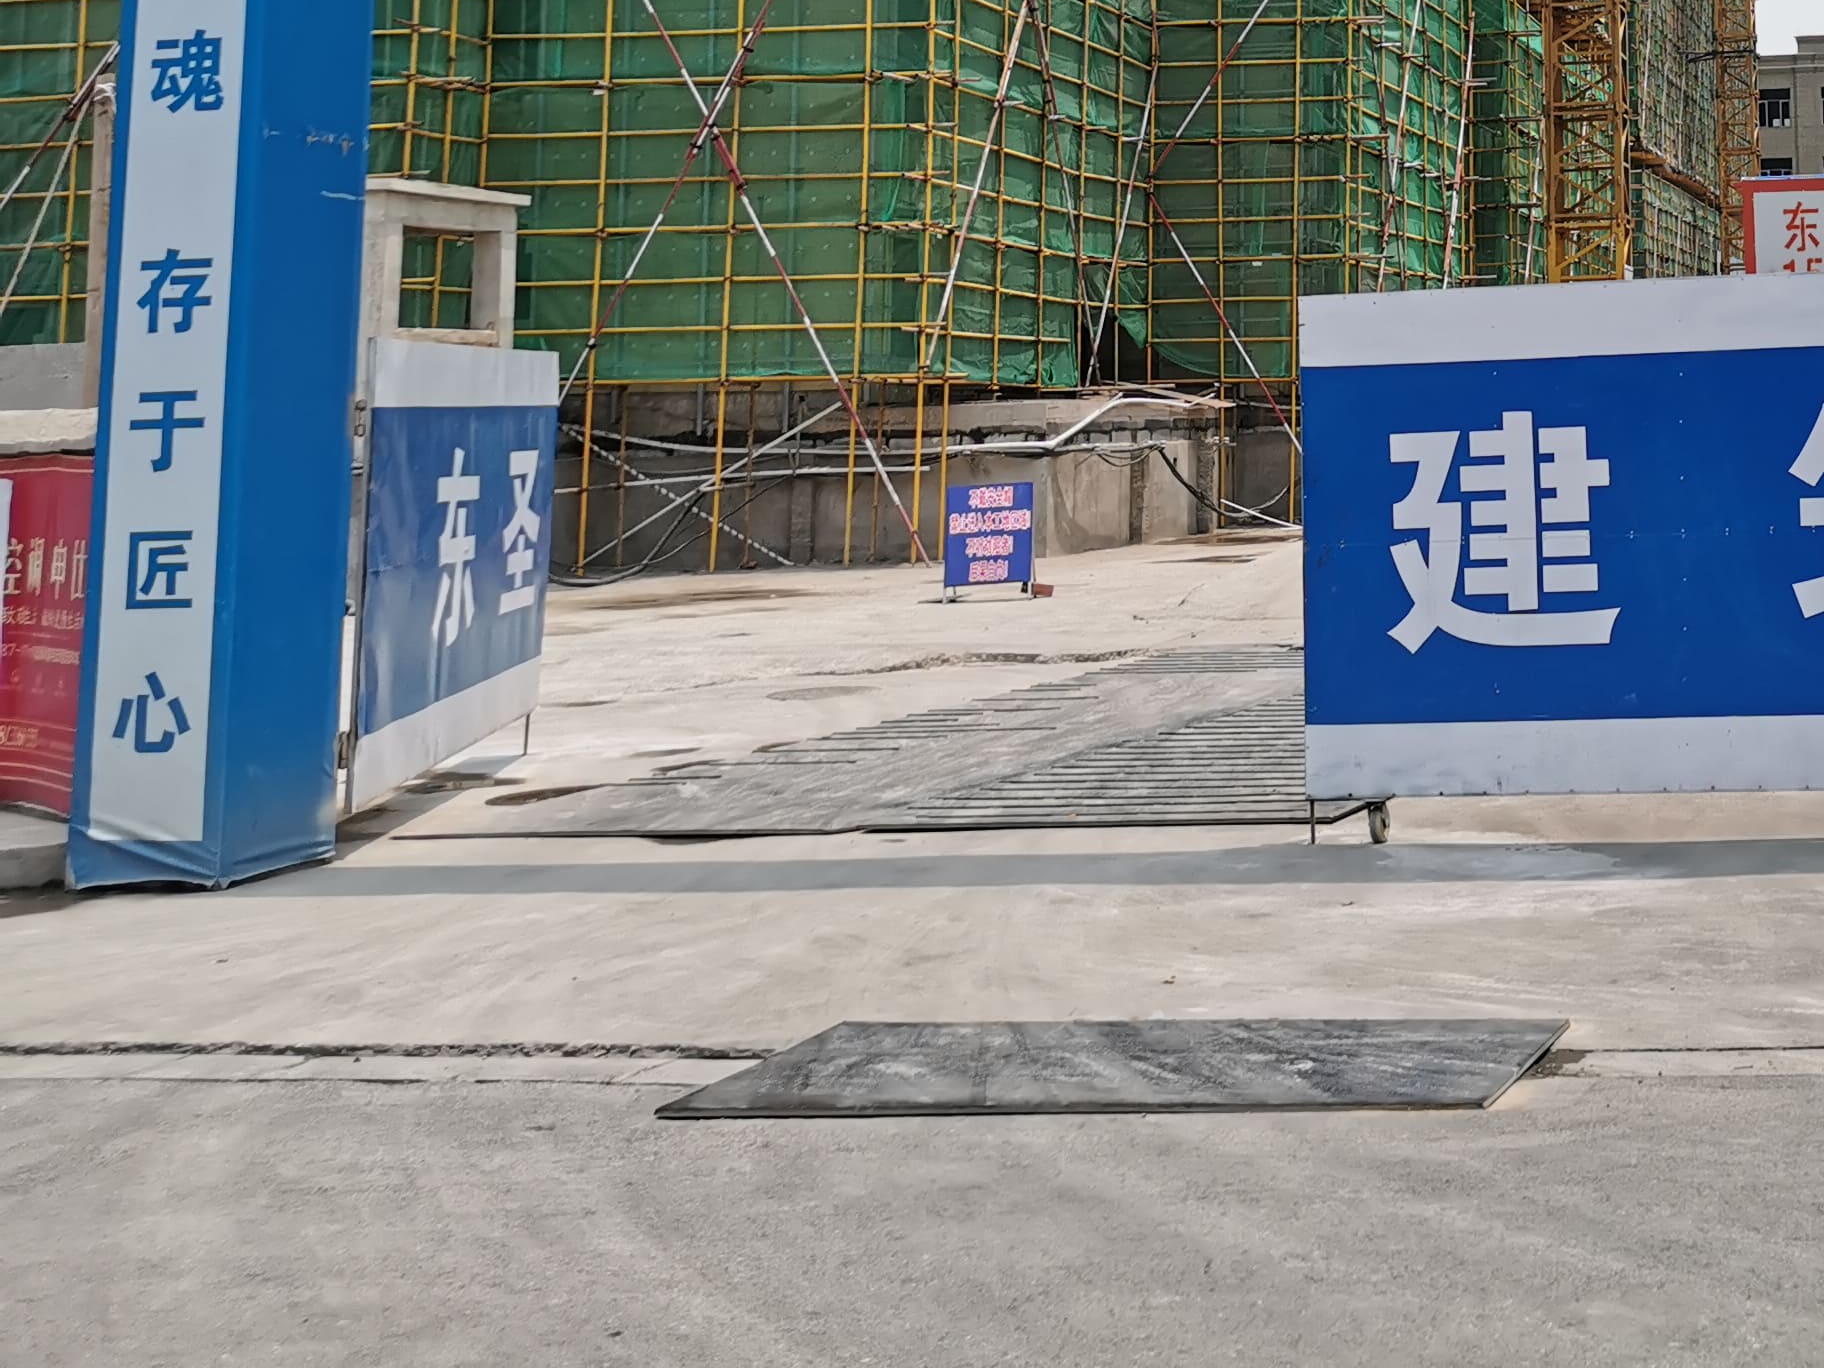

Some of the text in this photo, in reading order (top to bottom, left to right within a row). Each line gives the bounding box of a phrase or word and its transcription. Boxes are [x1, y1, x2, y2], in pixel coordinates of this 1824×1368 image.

[112, 248, 213, 754] 存于匠心
[431, 447, 541, 648] 东圣
